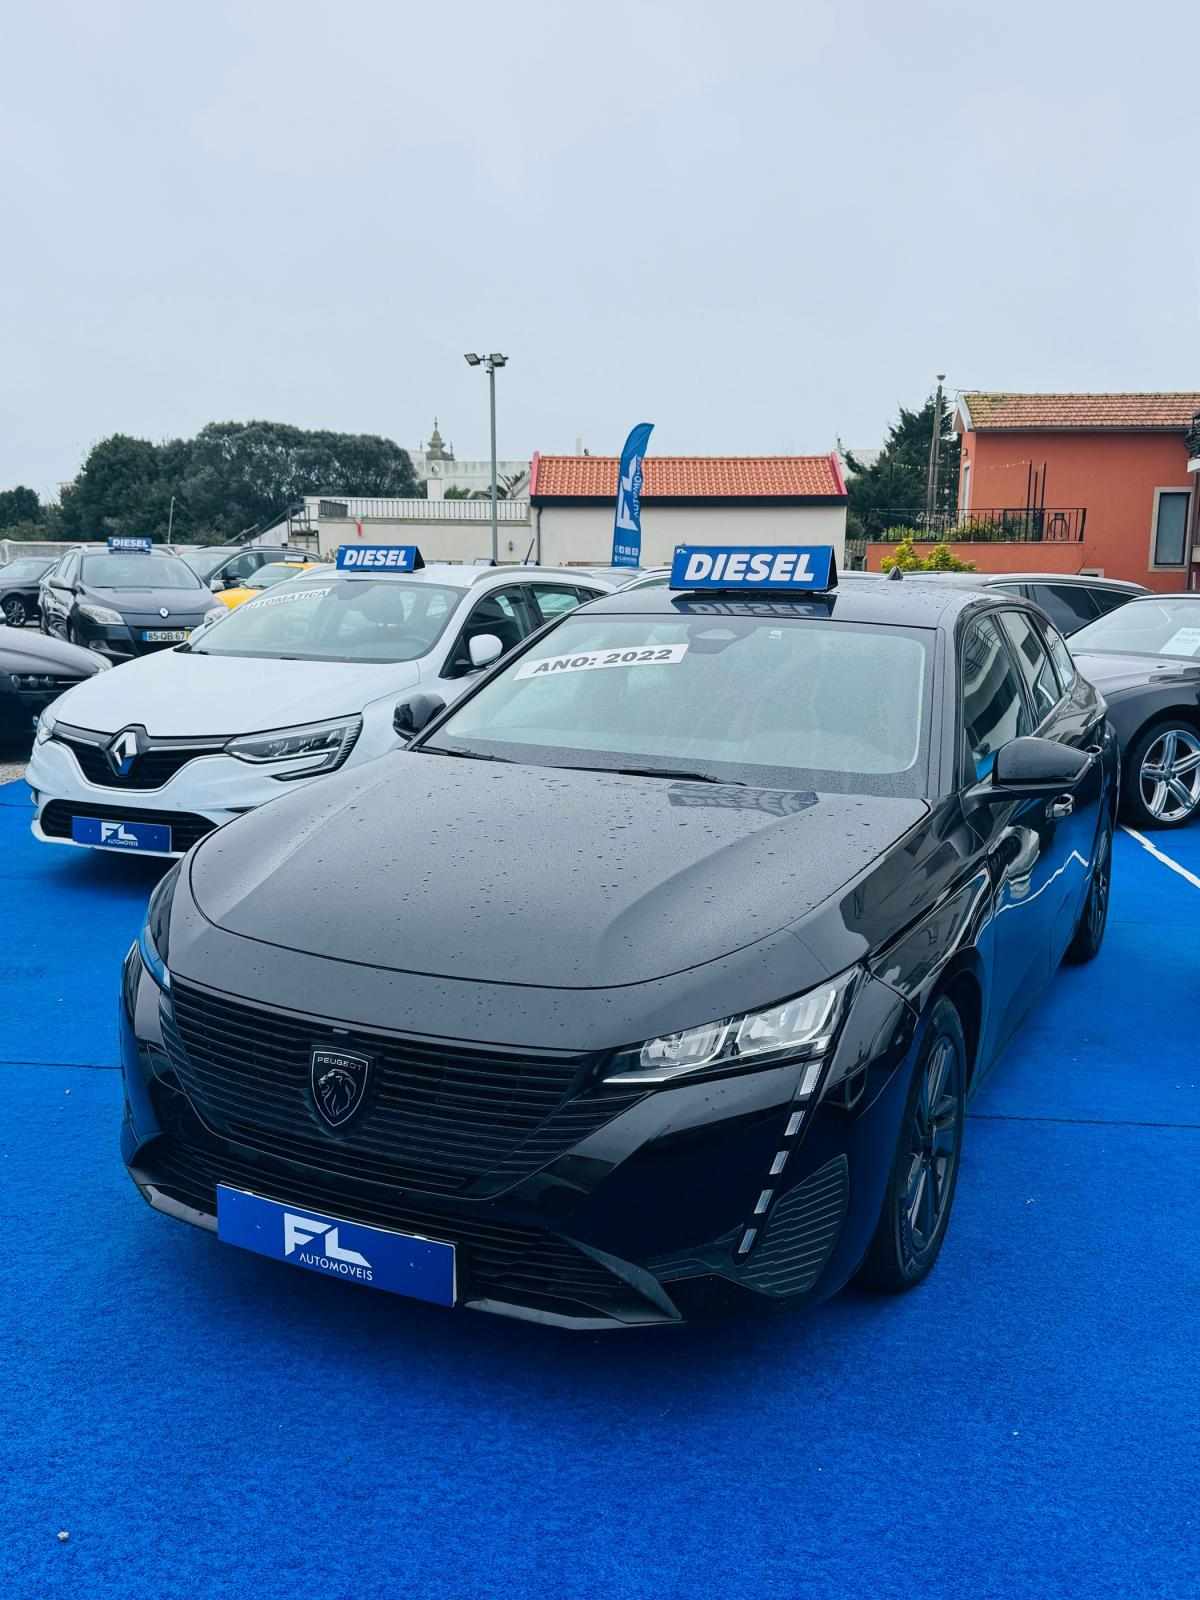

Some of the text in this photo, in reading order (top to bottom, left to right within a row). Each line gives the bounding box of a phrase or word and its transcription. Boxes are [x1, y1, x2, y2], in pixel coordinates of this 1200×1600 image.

[112, 538, 149, 549] DIESEL
[343, 549, 408, 567] DIESEL
[683, 553, 815, 582] DIESEL
[533, 649, 674, 674] ANO: 2022
[101, 822, 138, 842] FL
[317, 1056, 362, 1071] PEUGEOT
[284, 1212, 373, 1268] FL
[299, 1252, 373, 1281] AUTOMOVEIS
